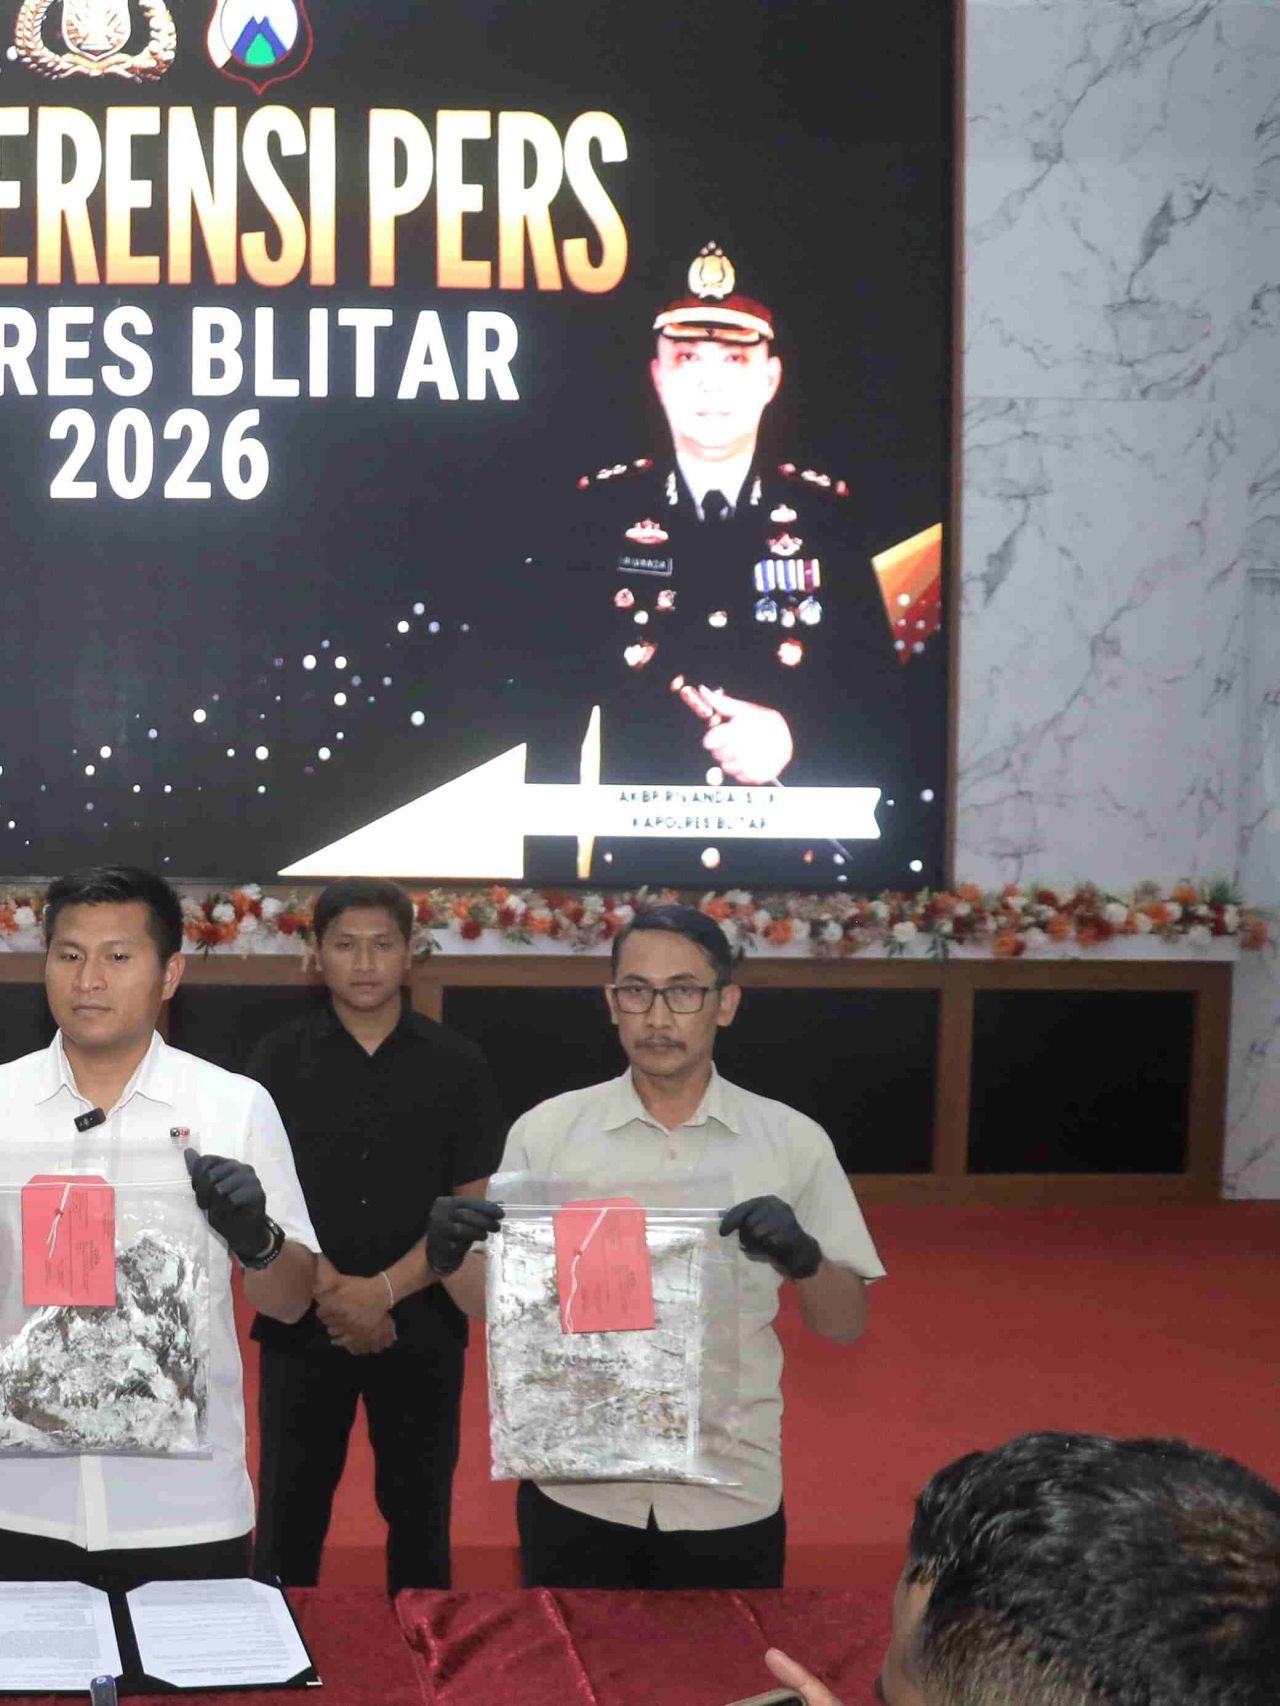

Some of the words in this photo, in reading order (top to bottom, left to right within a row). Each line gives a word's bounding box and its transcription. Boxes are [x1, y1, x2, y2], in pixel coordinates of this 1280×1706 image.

[367, 108, 629, 293] PERS
[191, 306, 521, 402] BLITAR
[48, 407, 270, 502] 2026
[632, 816, 710, 829] KAPORES
